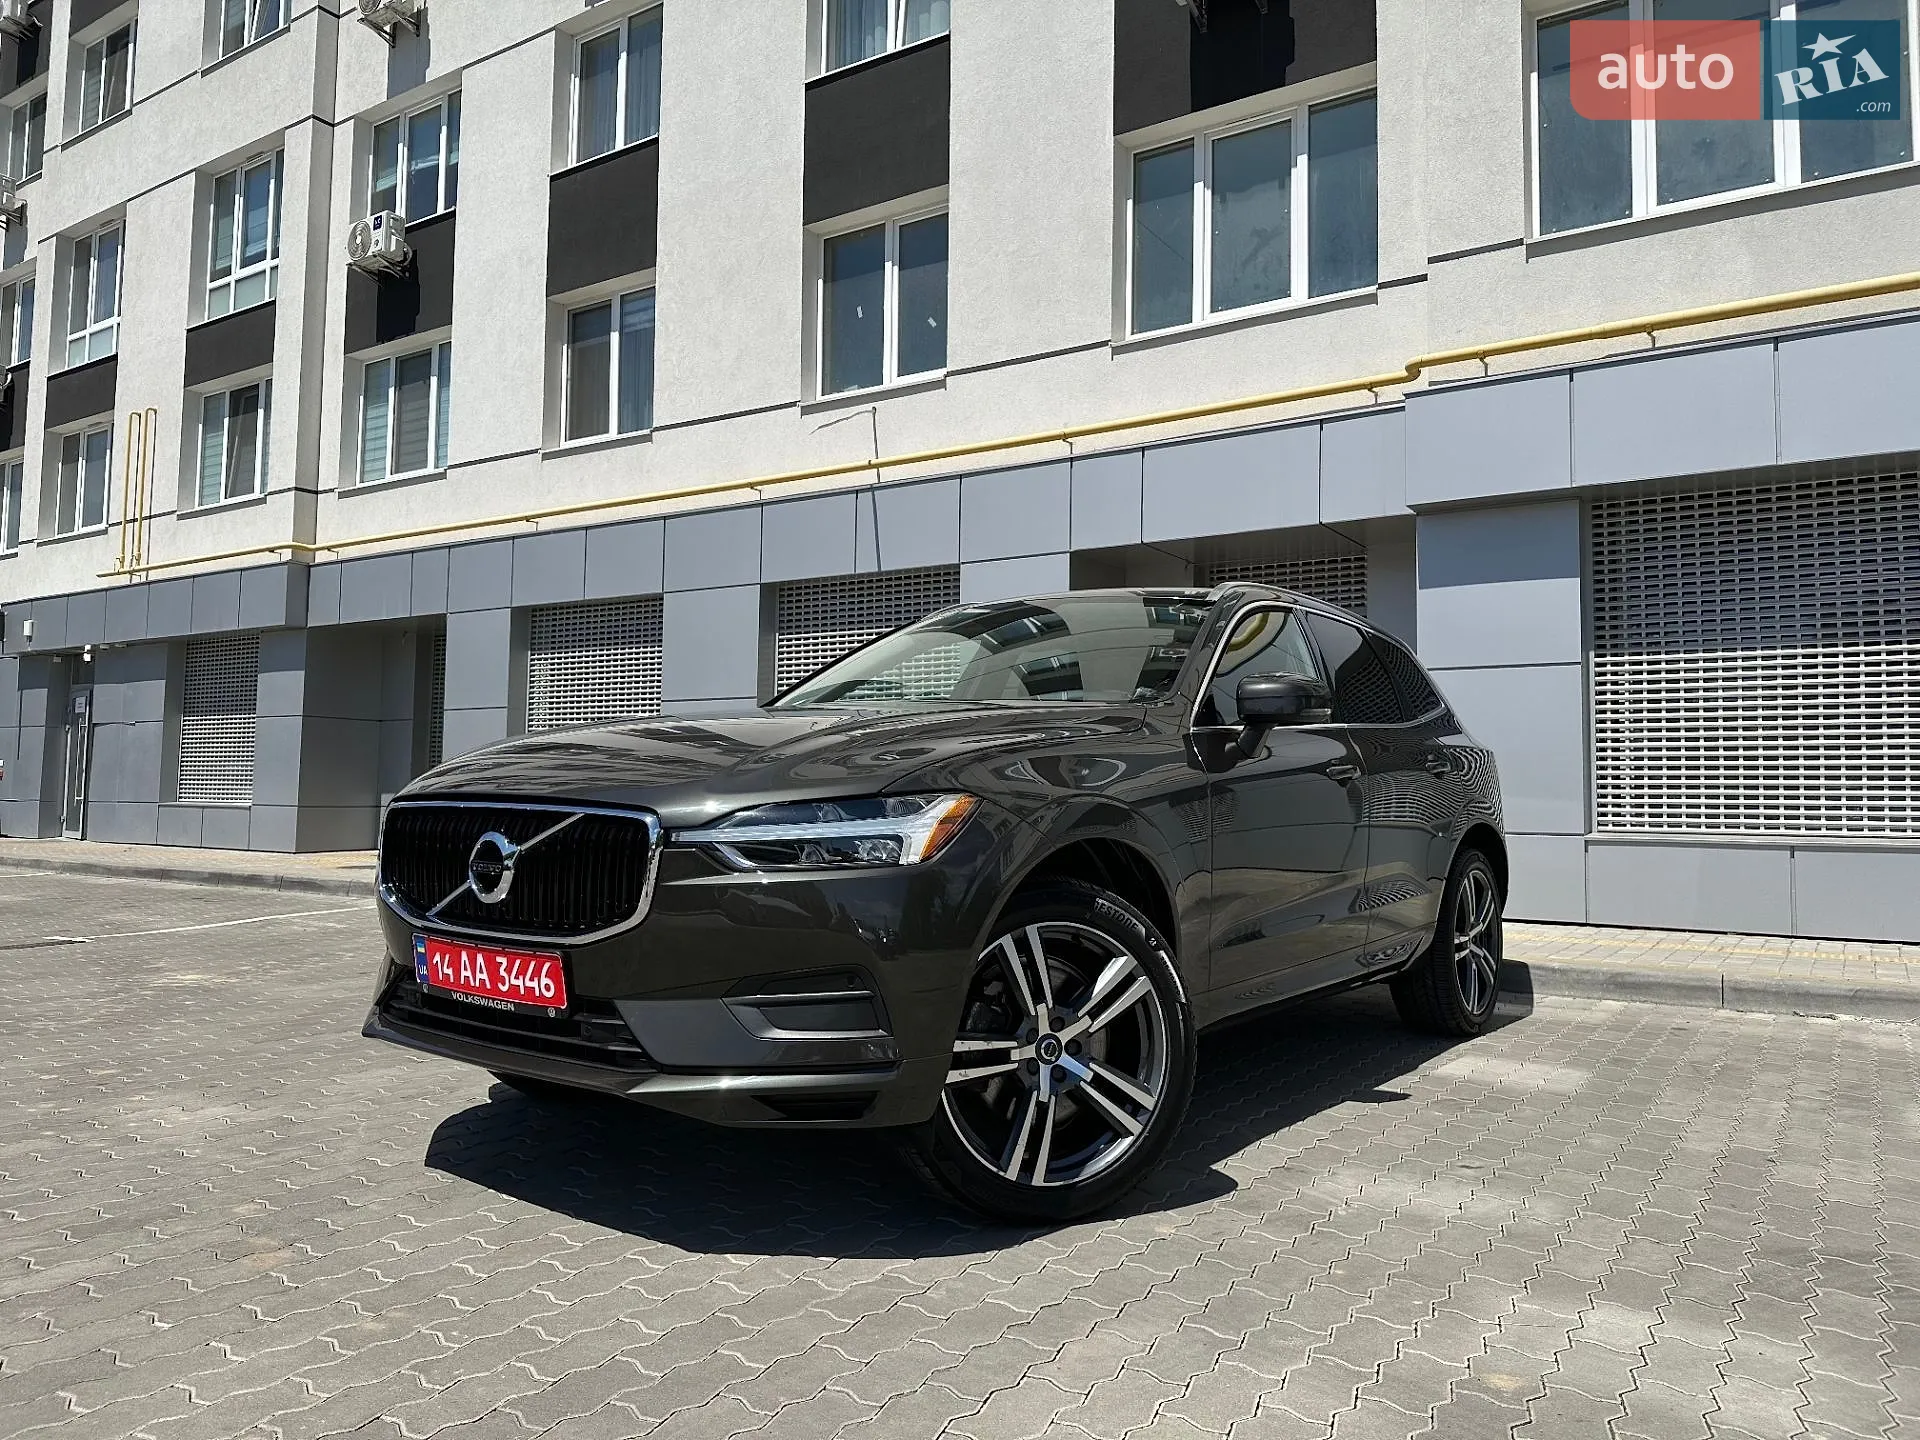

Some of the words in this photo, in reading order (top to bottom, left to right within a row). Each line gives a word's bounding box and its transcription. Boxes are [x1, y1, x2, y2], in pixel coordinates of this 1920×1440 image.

[418, 965, 428, 975] UA
[432, 952, 454, 983] 14
[460, 950, 491, 989] AA
[495, 956, 555, 998] 3446
[451, 991, 515, 1011] VOLKSWAGEN
